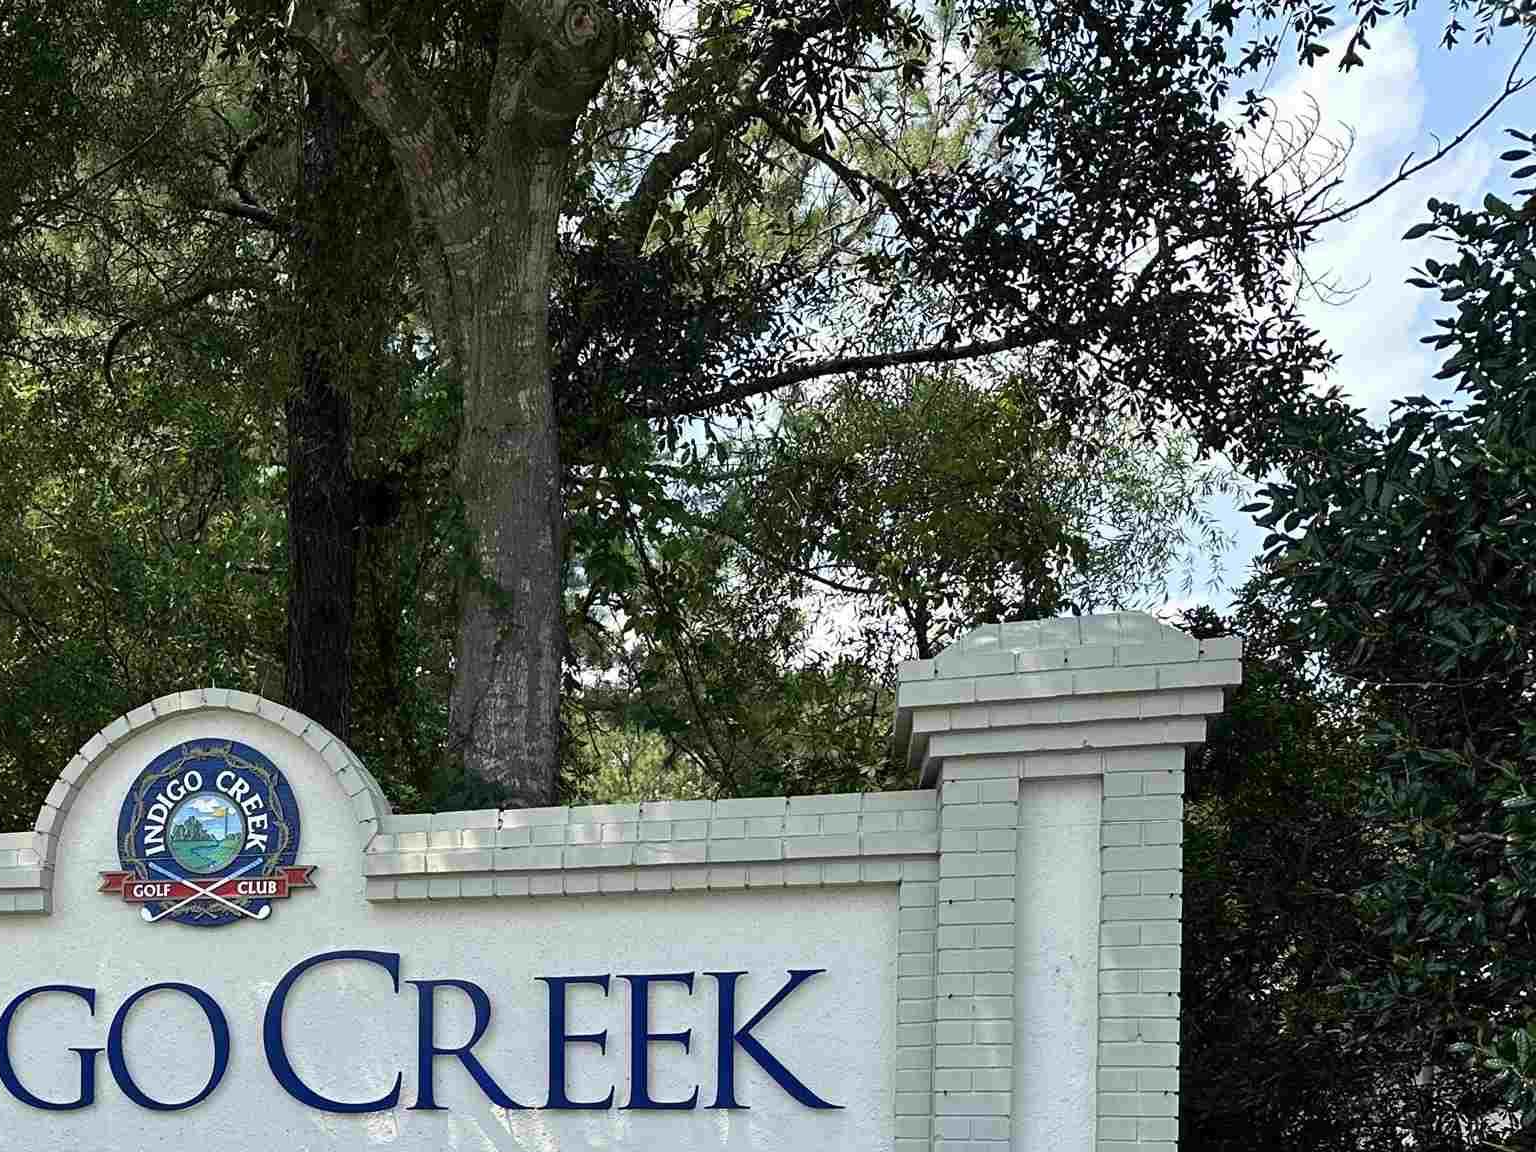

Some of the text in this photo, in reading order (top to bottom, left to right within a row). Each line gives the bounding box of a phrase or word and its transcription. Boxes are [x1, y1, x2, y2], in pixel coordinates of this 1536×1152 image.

[144, 770, 269, 857] INDIGO CREEK
[133, 881, 277, 898] GOLF CLUB
[263, 950, 845, 1113] CREEK
